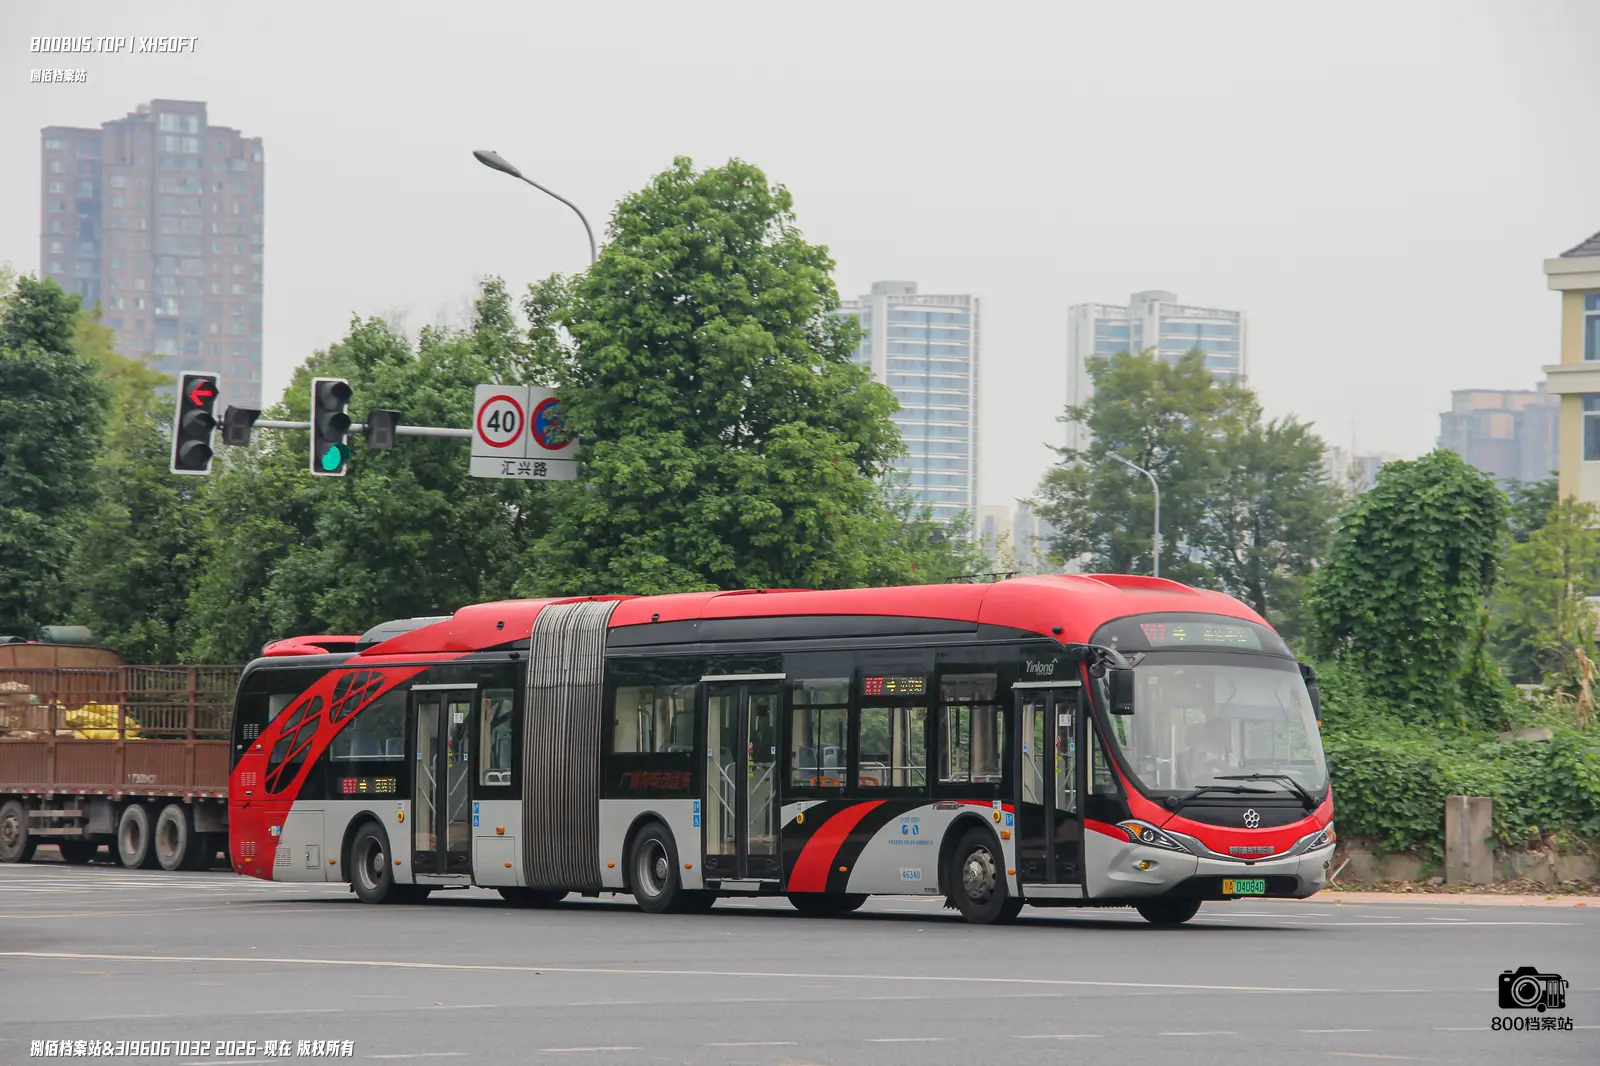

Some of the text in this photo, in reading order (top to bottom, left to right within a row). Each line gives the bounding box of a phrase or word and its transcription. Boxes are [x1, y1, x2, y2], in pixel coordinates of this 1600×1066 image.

[487, 410, 516, 433] 40
[501, 460, 548, 477] 汇兴路
[1026, 660, 1055, 675] Yinlong
[902, 870, 920, 879] 46340
